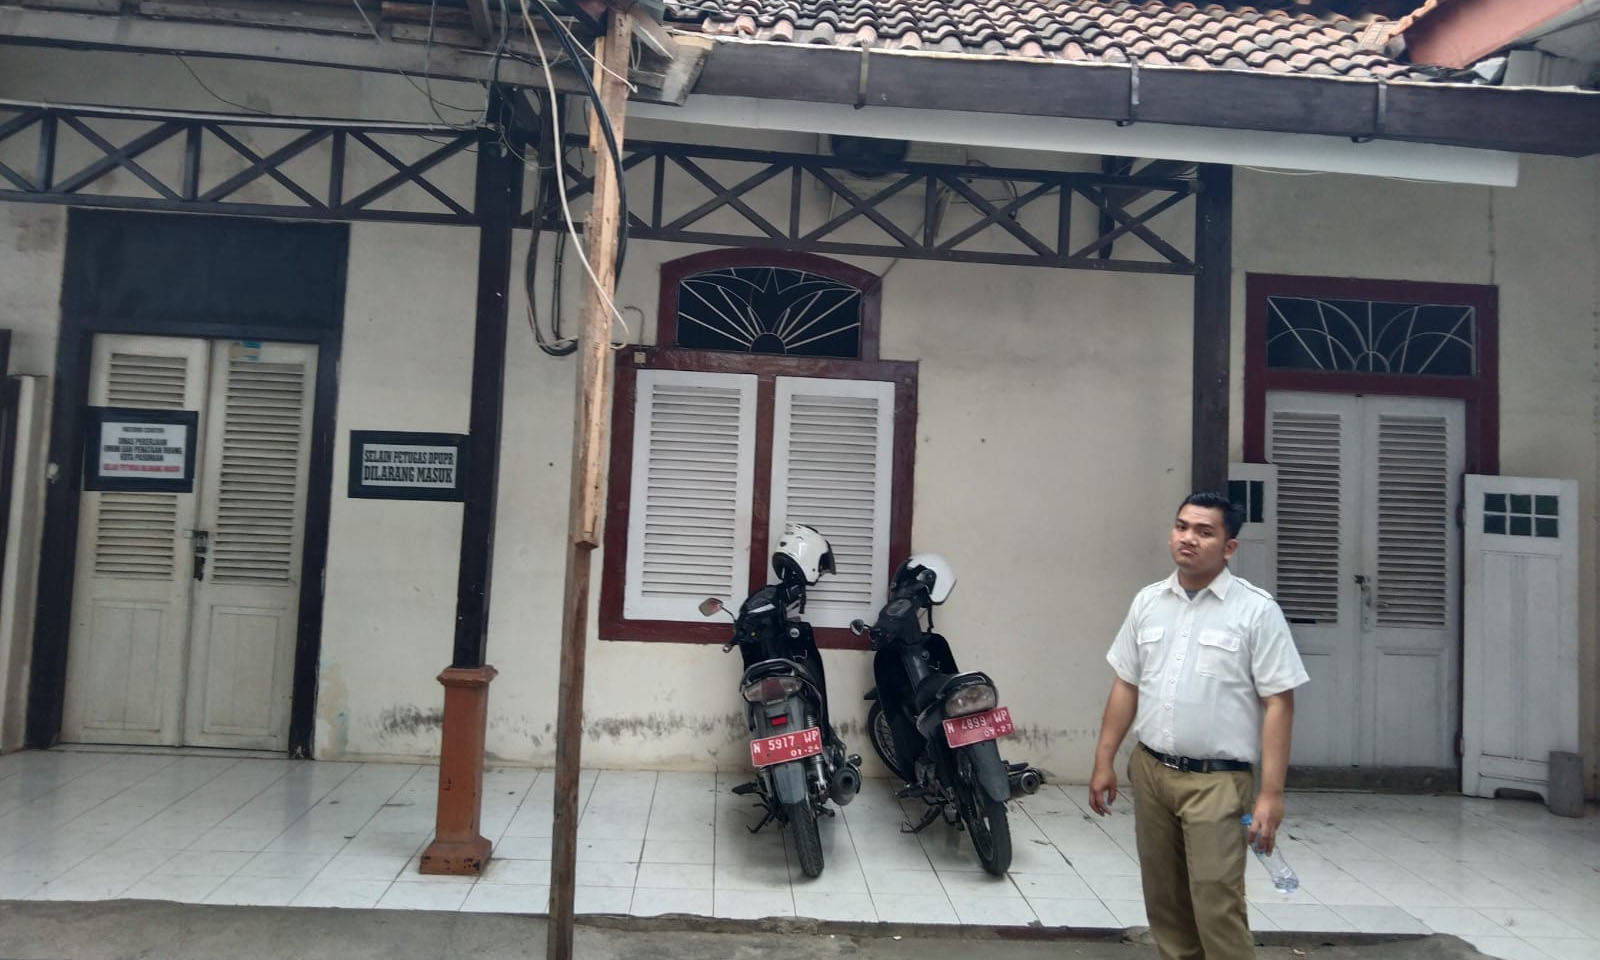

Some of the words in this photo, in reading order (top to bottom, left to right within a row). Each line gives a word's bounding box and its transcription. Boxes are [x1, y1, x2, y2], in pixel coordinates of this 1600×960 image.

[365, 450, 392, 463] SELAIN
[393, 451, 427, 464] PETUGAS
[364, 466, 415, 482] DILARANG
[416, 467, 453, 483] MASUK
[946, 722, 955, 734] N
[993, 710, 1007, 723] WP
[753, 743, 761, 754] N
[768, 735, 795, 751] 5917
[803, 730, 819, 743] WP
